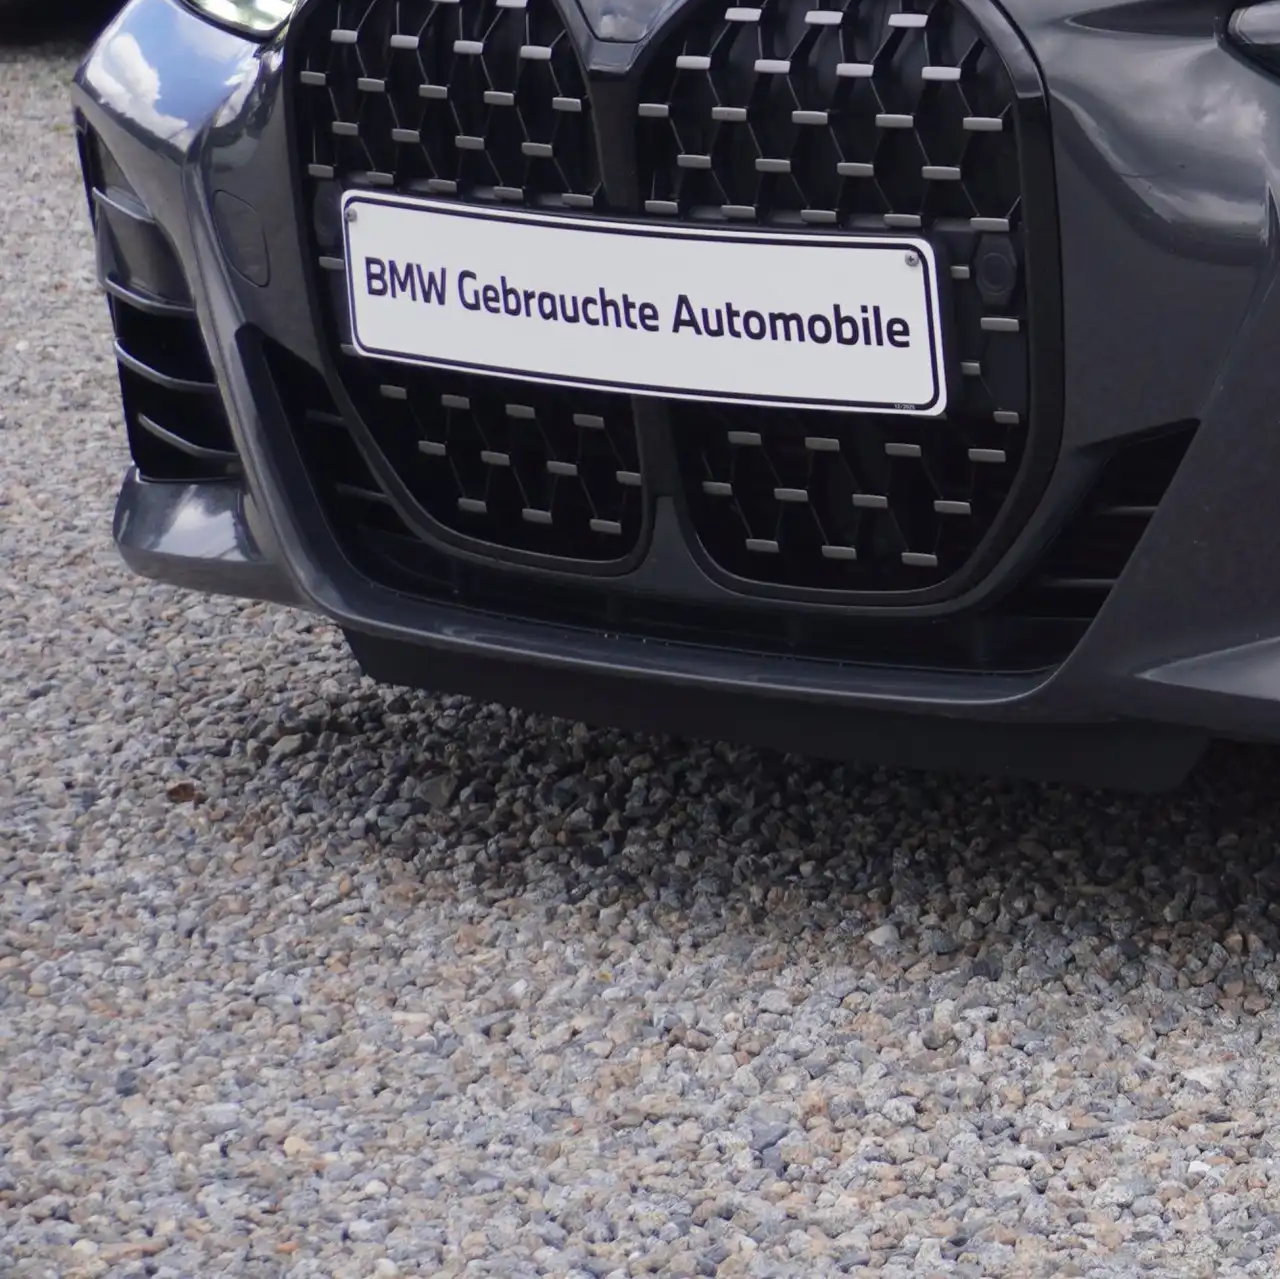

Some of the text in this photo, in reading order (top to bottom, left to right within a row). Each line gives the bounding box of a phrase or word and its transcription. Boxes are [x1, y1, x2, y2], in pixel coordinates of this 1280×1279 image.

[365, 256, 910, 348] BMW Gebrauchte Automobile
